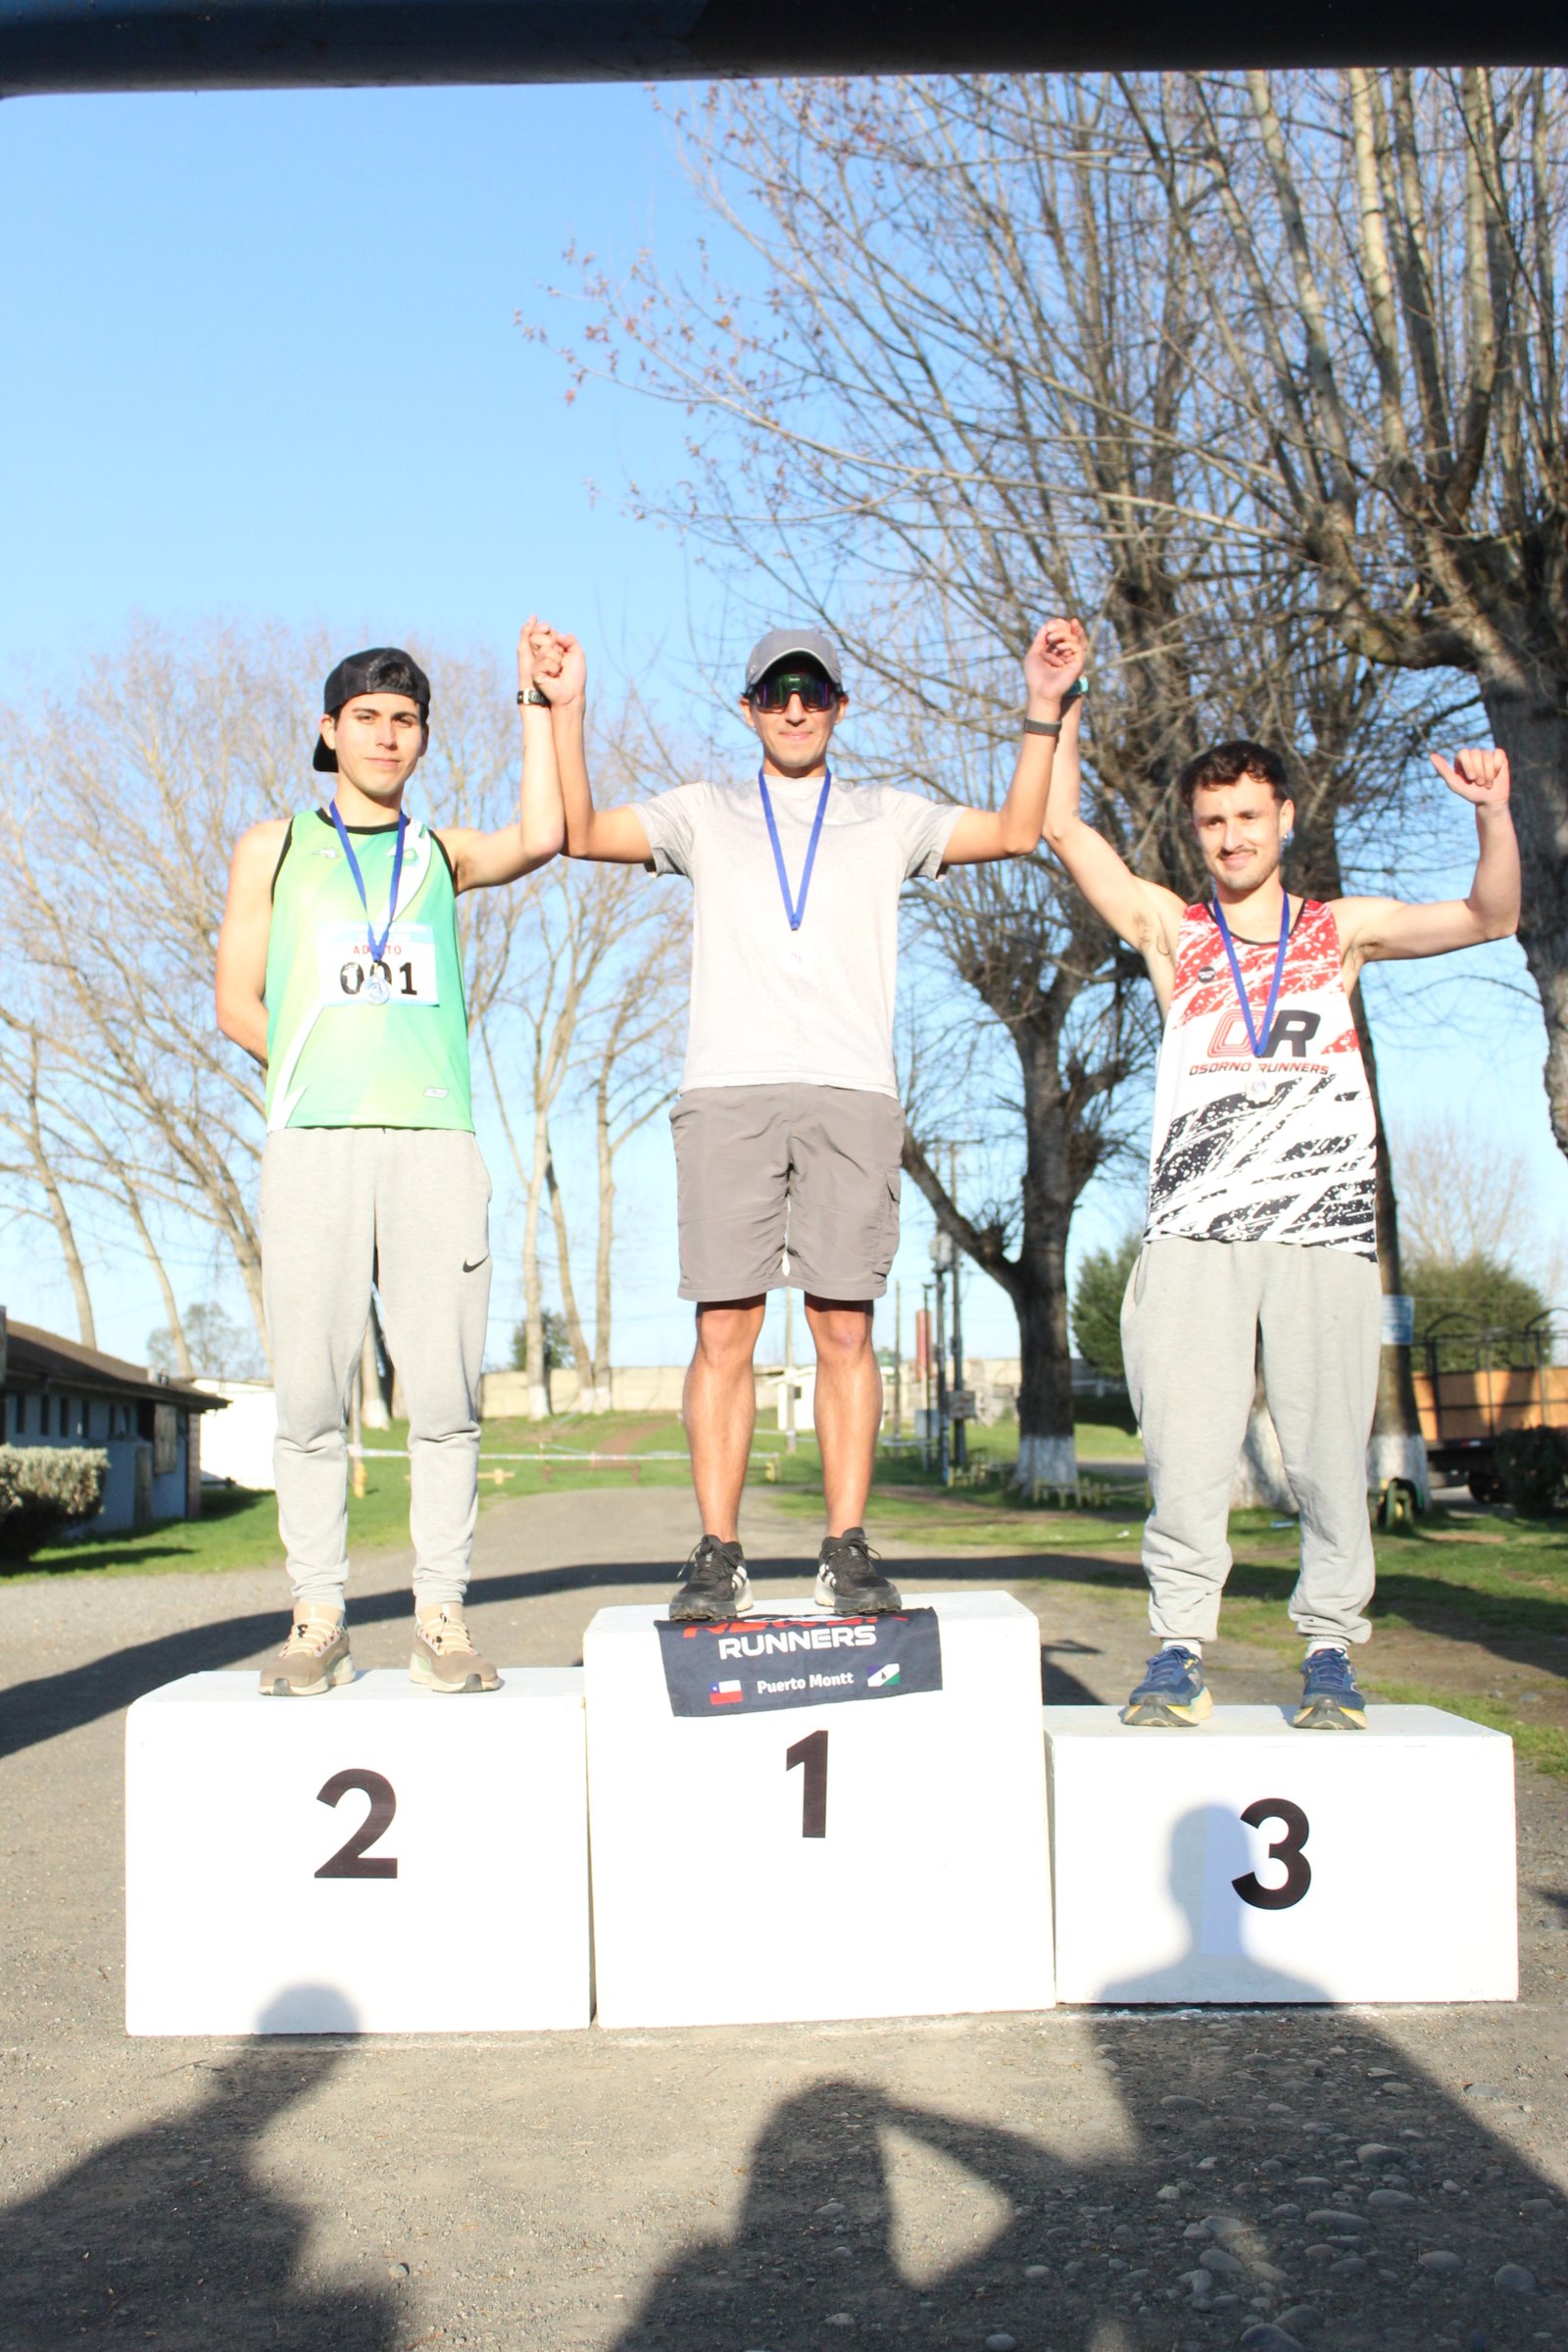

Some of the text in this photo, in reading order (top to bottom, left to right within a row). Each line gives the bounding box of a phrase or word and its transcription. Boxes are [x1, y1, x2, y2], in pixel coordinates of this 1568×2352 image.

[353, 945, 402, 956] ADTO
[1189, 1061, 1329, 1076] OSORNO RUNNERS
[717, 1625, 877, 1660] RUNNERS
[757, 1672, 855, 1694] Puerto Montt
[786, 1730, 828, 1838] 1
[314, 1768, 398, 1879] 2
[1231, 1797, 1312, 1911] 3
